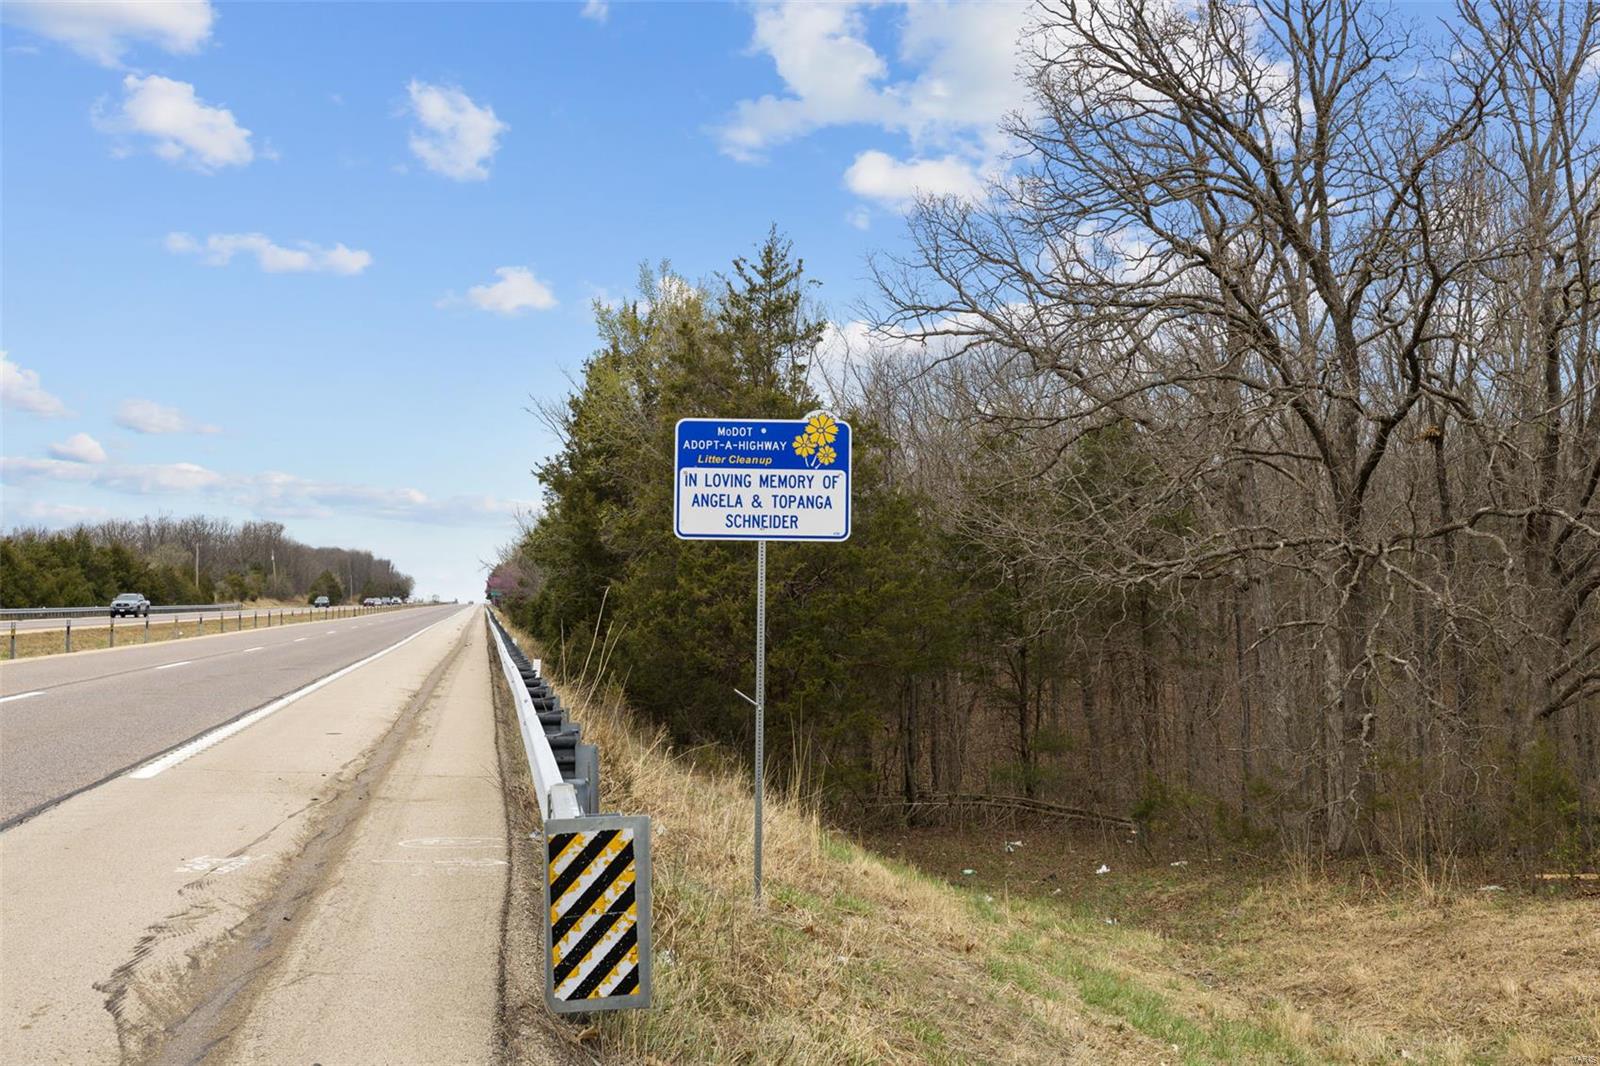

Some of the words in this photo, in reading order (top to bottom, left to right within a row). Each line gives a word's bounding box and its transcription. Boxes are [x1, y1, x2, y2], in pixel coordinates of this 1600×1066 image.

[717, 427, 752, 437] MoDOT
[683, 440, 787, 450] ADOPT-A-HIGHWAY
[698, 455, 725, 463] Litter
[729, 455, 772, 465] Cleanup
[685, 473, 697, 487] IN
[705, 474, 752, 488] LOVING
[759, 475, 814, 489] MEMORY
[823, 476, 839, 489] OF
[692, 494, 743, 508] ANGELA
[752, 495, 763, 508] &
[772, 495, 832, 509] TOPANGA
[725, 514, 799, 529] SCHNEIDER
